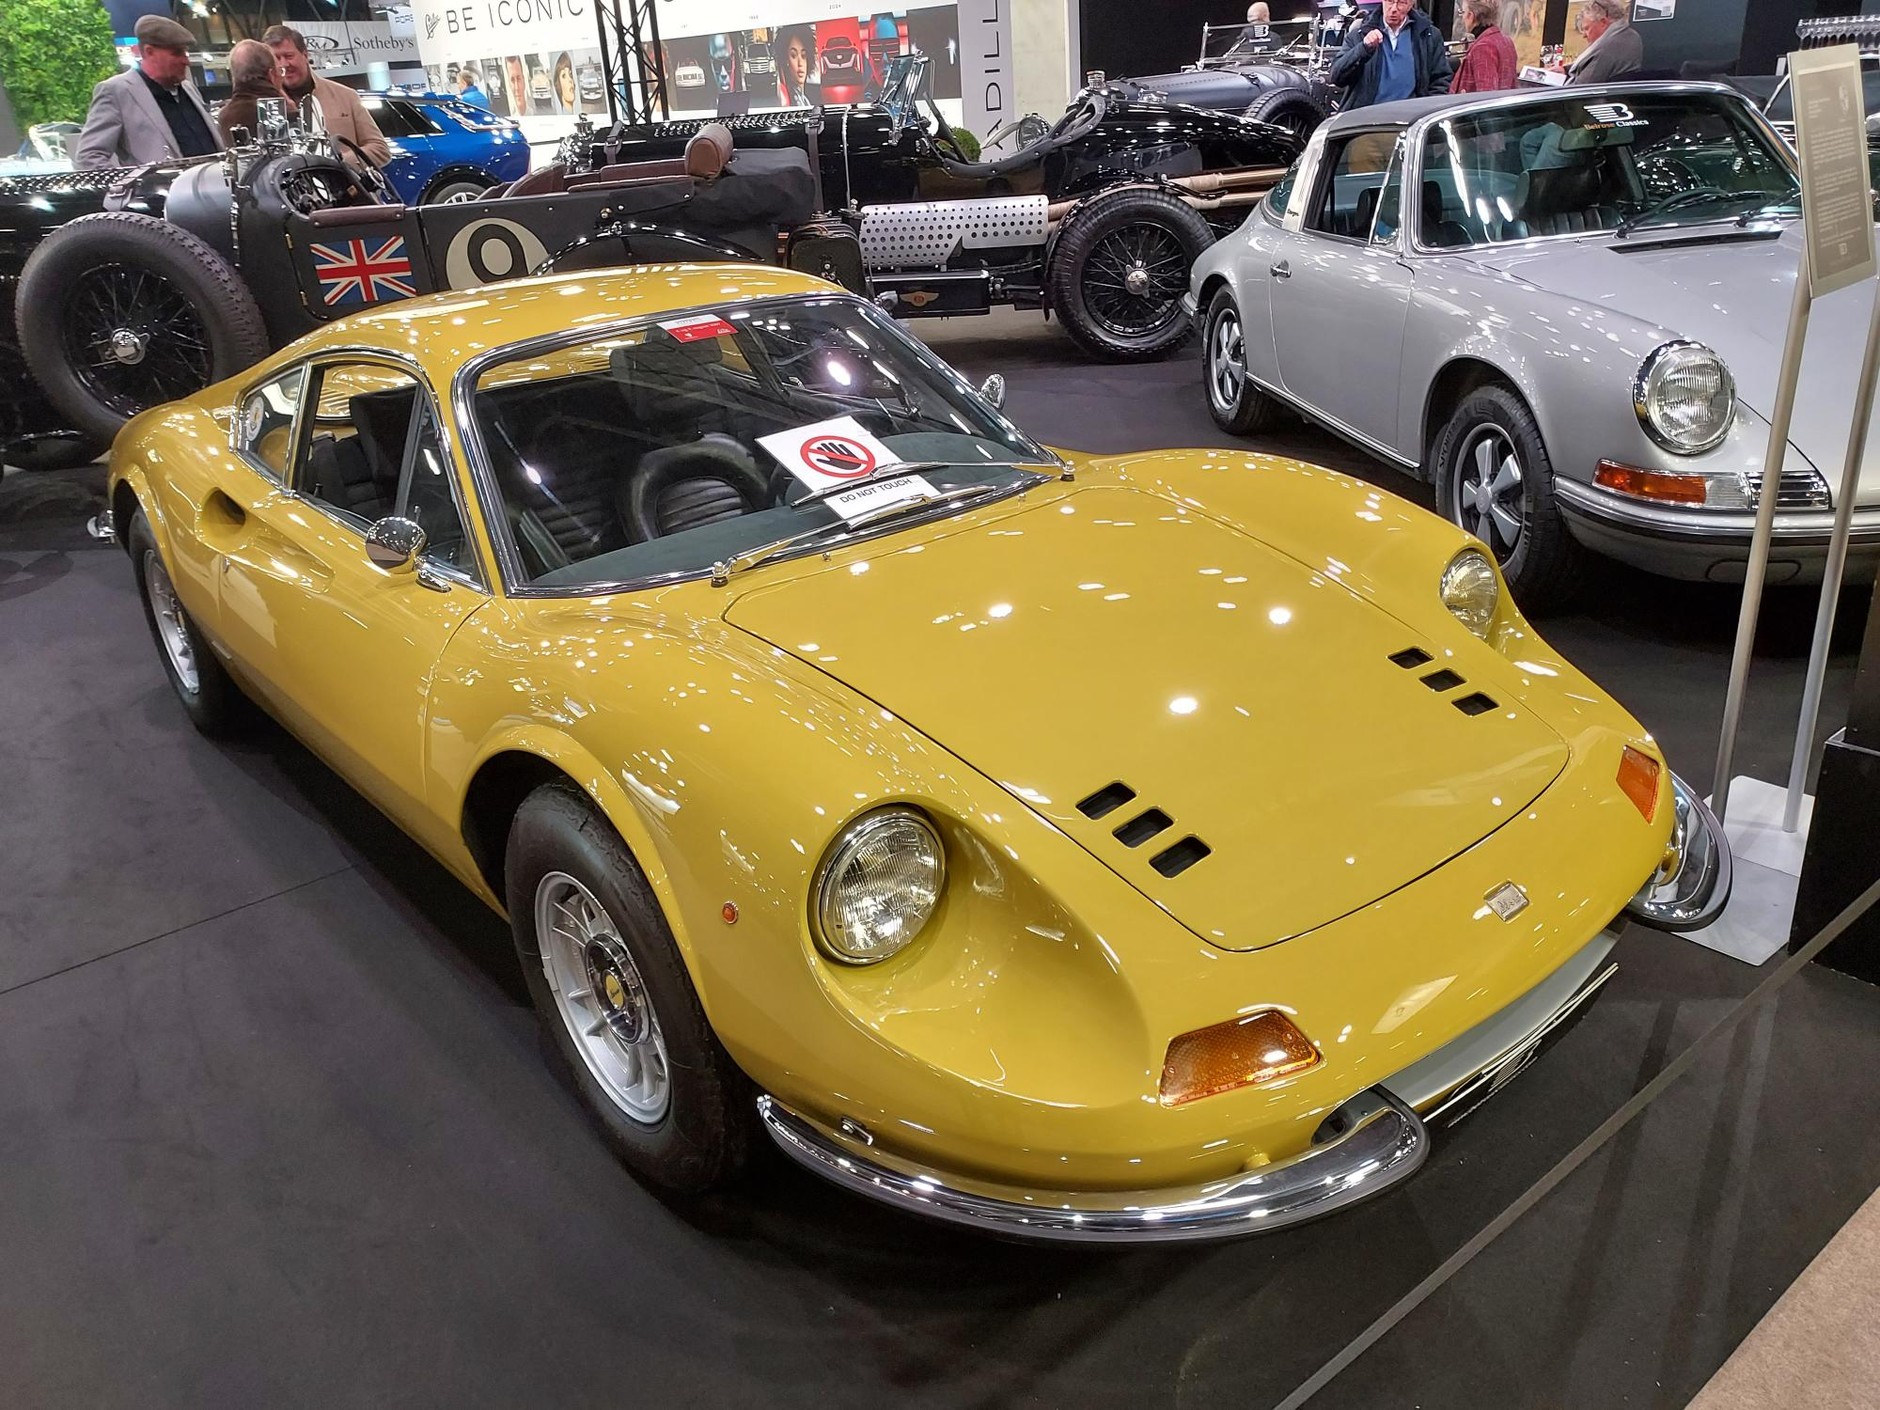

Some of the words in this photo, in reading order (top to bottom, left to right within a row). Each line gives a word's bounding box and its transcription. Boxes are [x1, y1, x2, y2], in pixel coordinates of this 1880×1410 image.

[446, 7, 476, 34] BE
[488, 0, 584, 28] ICONIC
[354, 35, 414, 51] Sotheby's
[1616, 119, 1650, 127] Classics
[840, 493, 856, 503] DO
[856, 487, 878, 498] NOT
[878, 478, 912, 491] TOUCH
